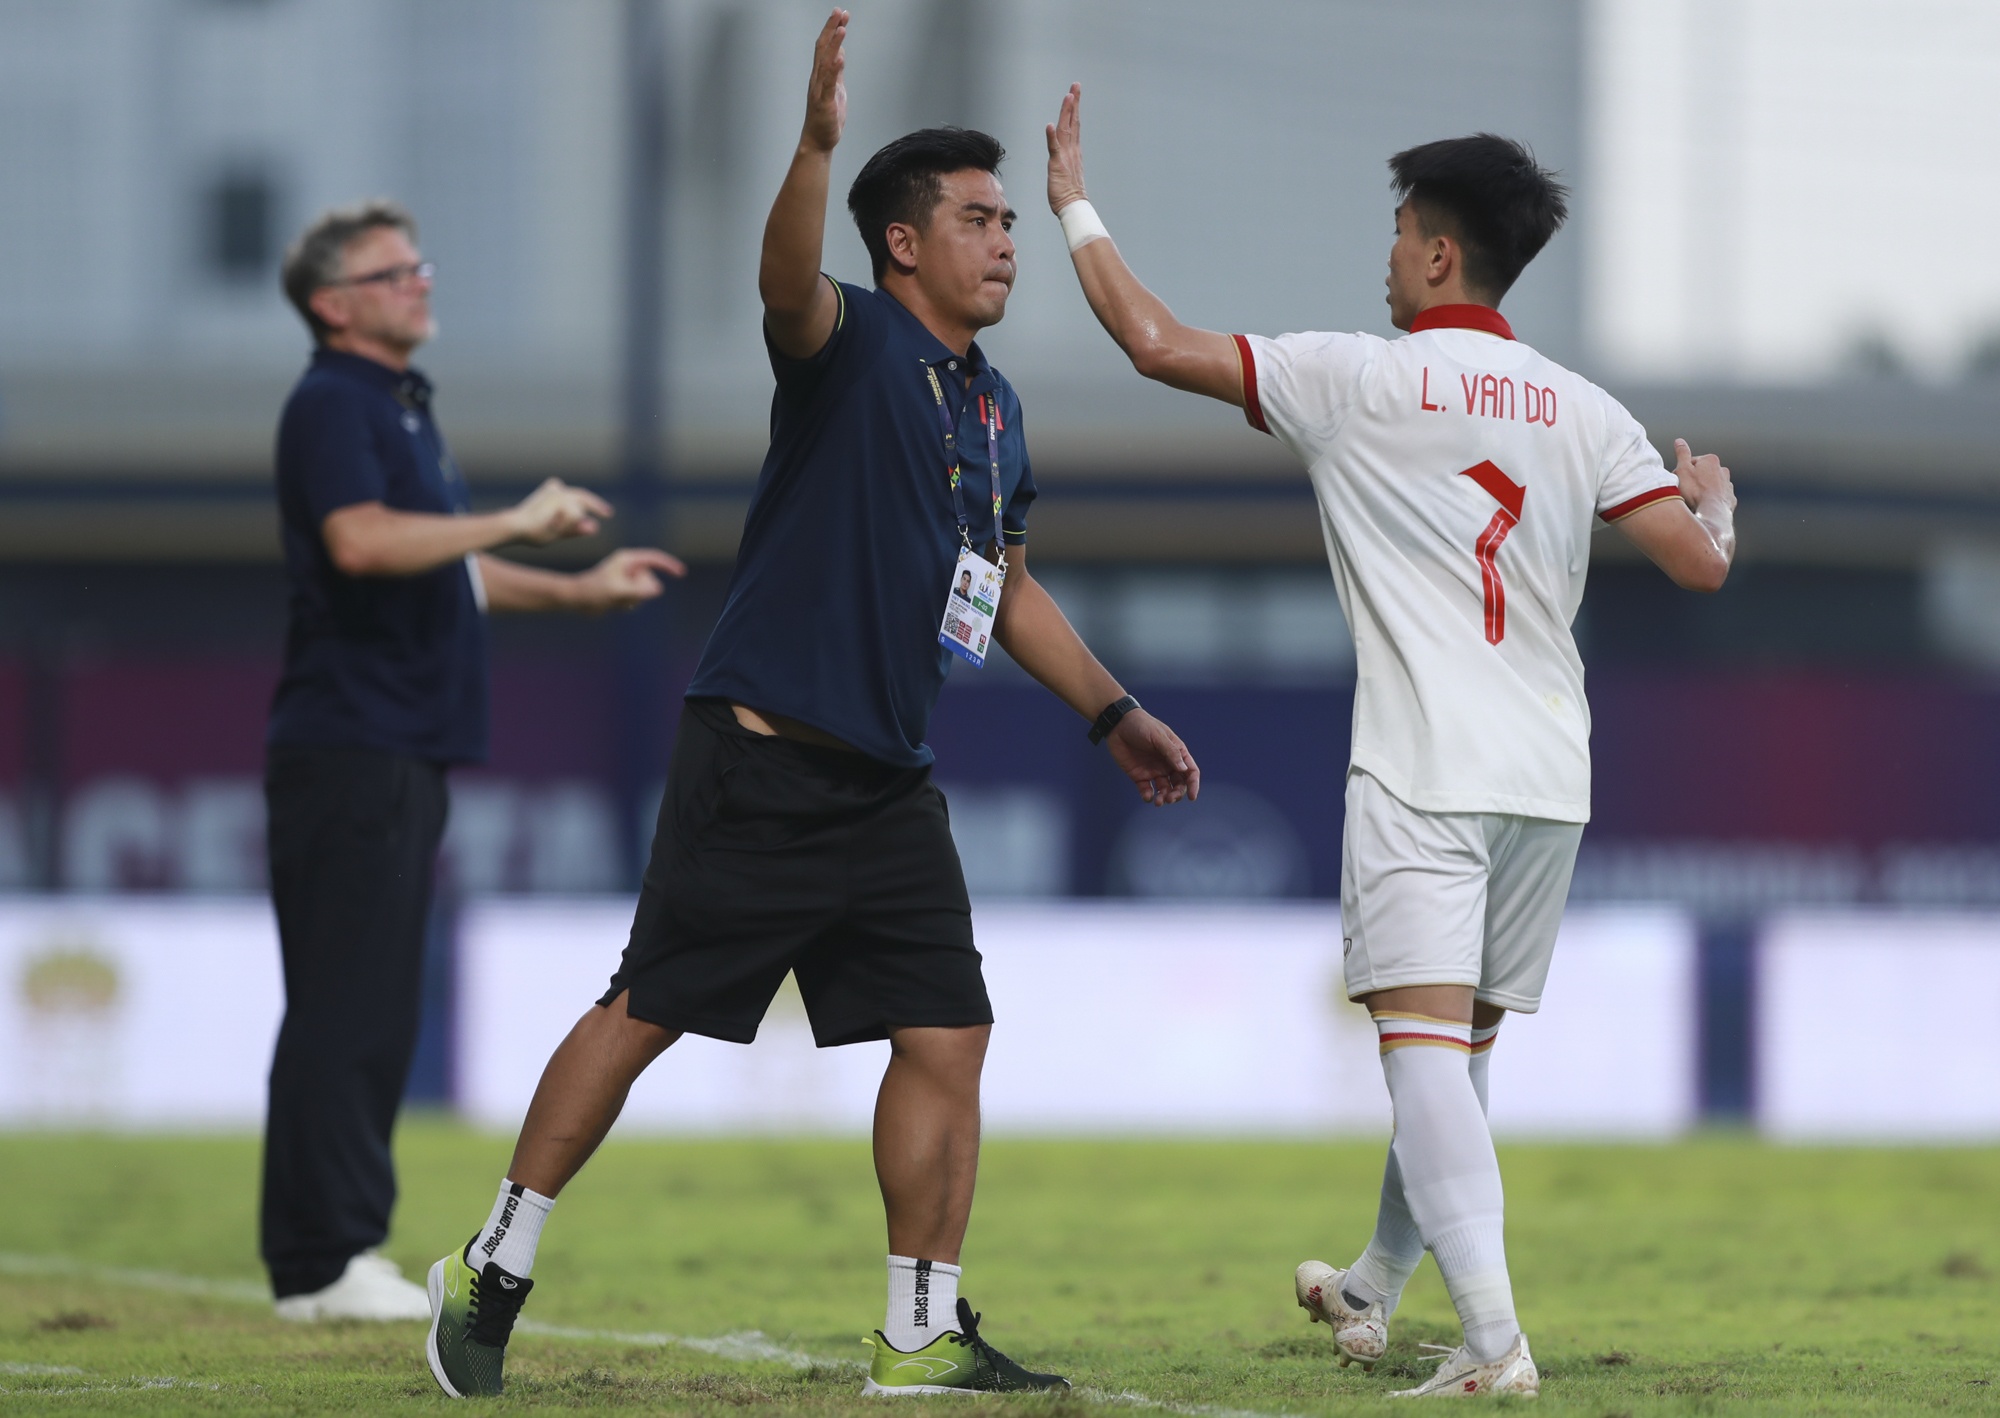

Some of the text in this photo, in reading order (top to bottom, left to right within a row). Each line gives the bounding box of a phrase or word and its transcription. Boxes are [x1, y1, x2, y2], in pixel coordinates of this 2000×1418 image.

[1421, 366, 1556, 428] L. VAN DO
[1457, 459, 1527, 646] 7
[481, 1196, 519, 1258] GRAND SPORT
[914, 1269, 930, 1328] RAND SPORT
